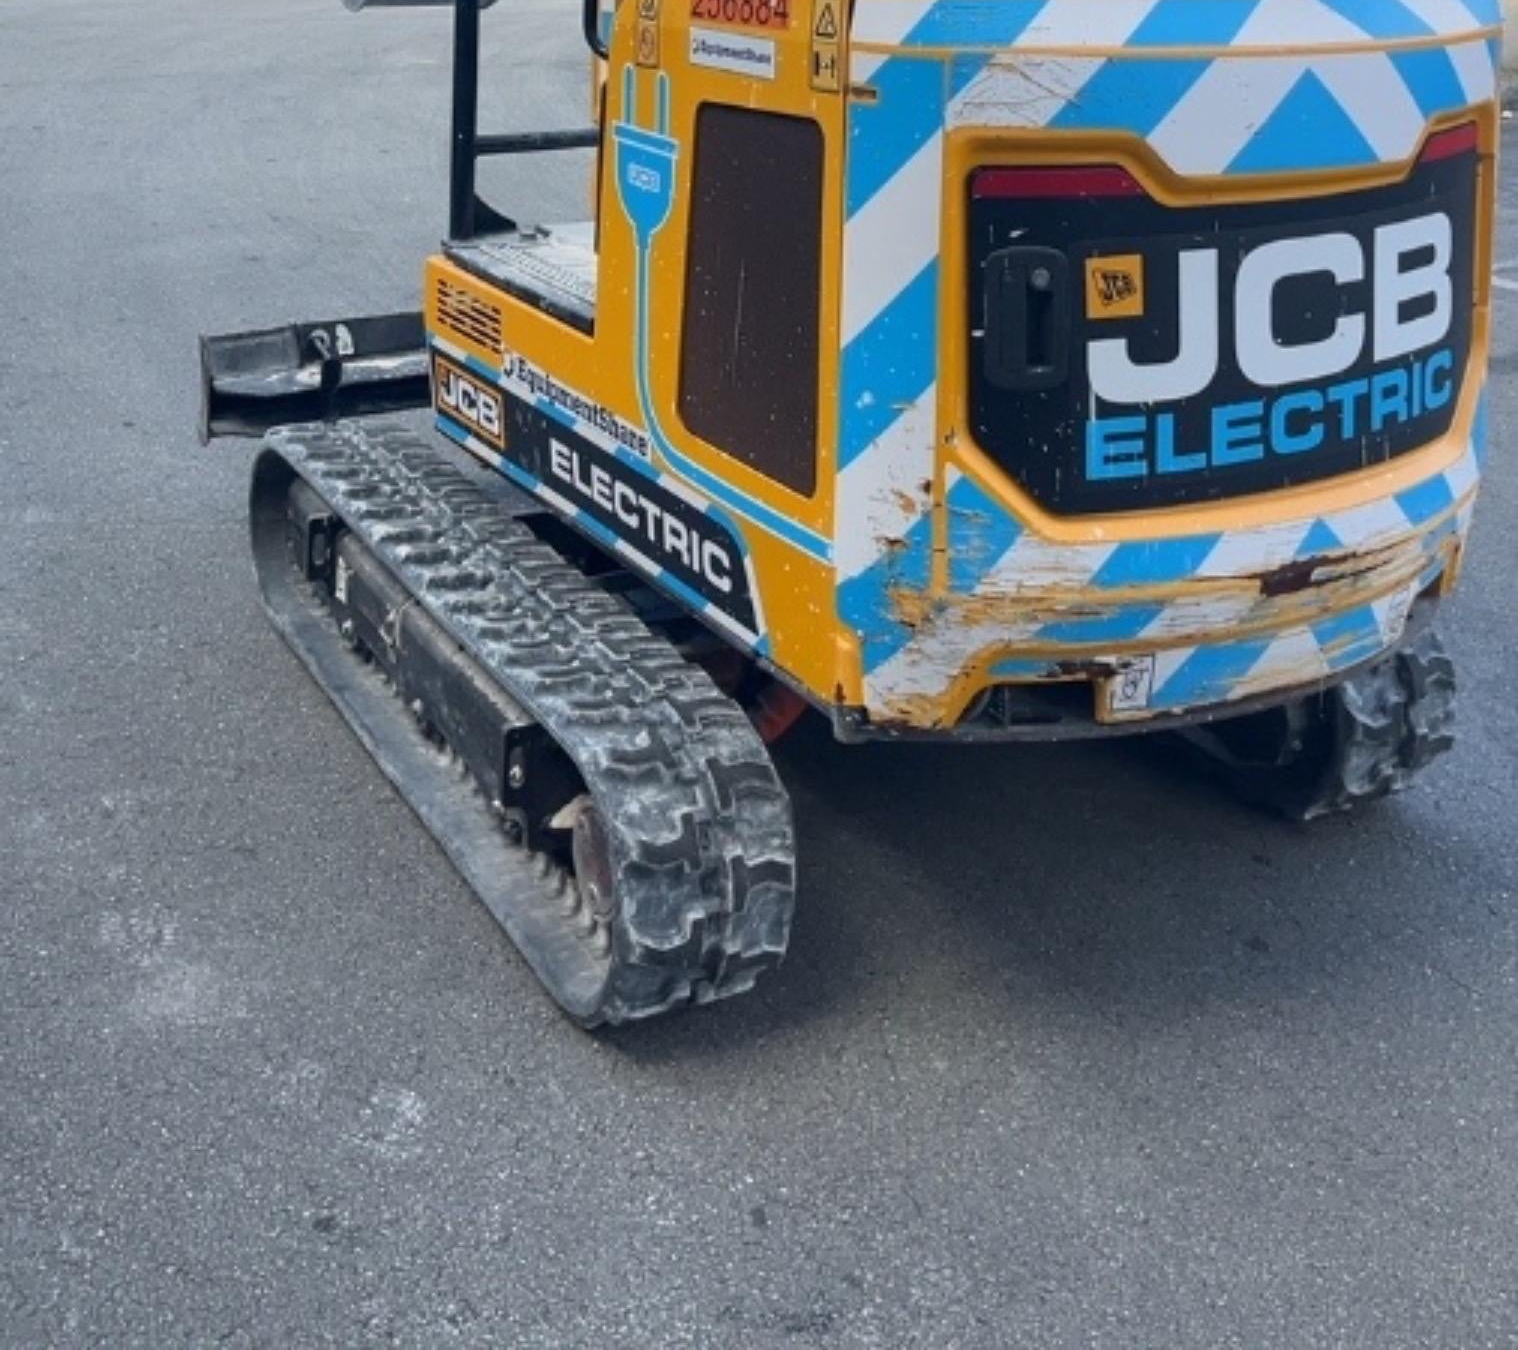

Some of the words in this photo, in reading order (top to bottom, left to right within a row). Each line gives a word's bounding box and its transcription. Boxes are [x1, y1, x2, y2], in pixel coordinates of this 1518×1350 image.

[1087, 212, 1452, 403] JCB
[440, 367, 500, 438] JCB
[517, 354, 648, 457] EquipmentShare
[1085, 350, 1453, 480] ELECTRIC
[550, 438, 732, 593] ELECTRIC
